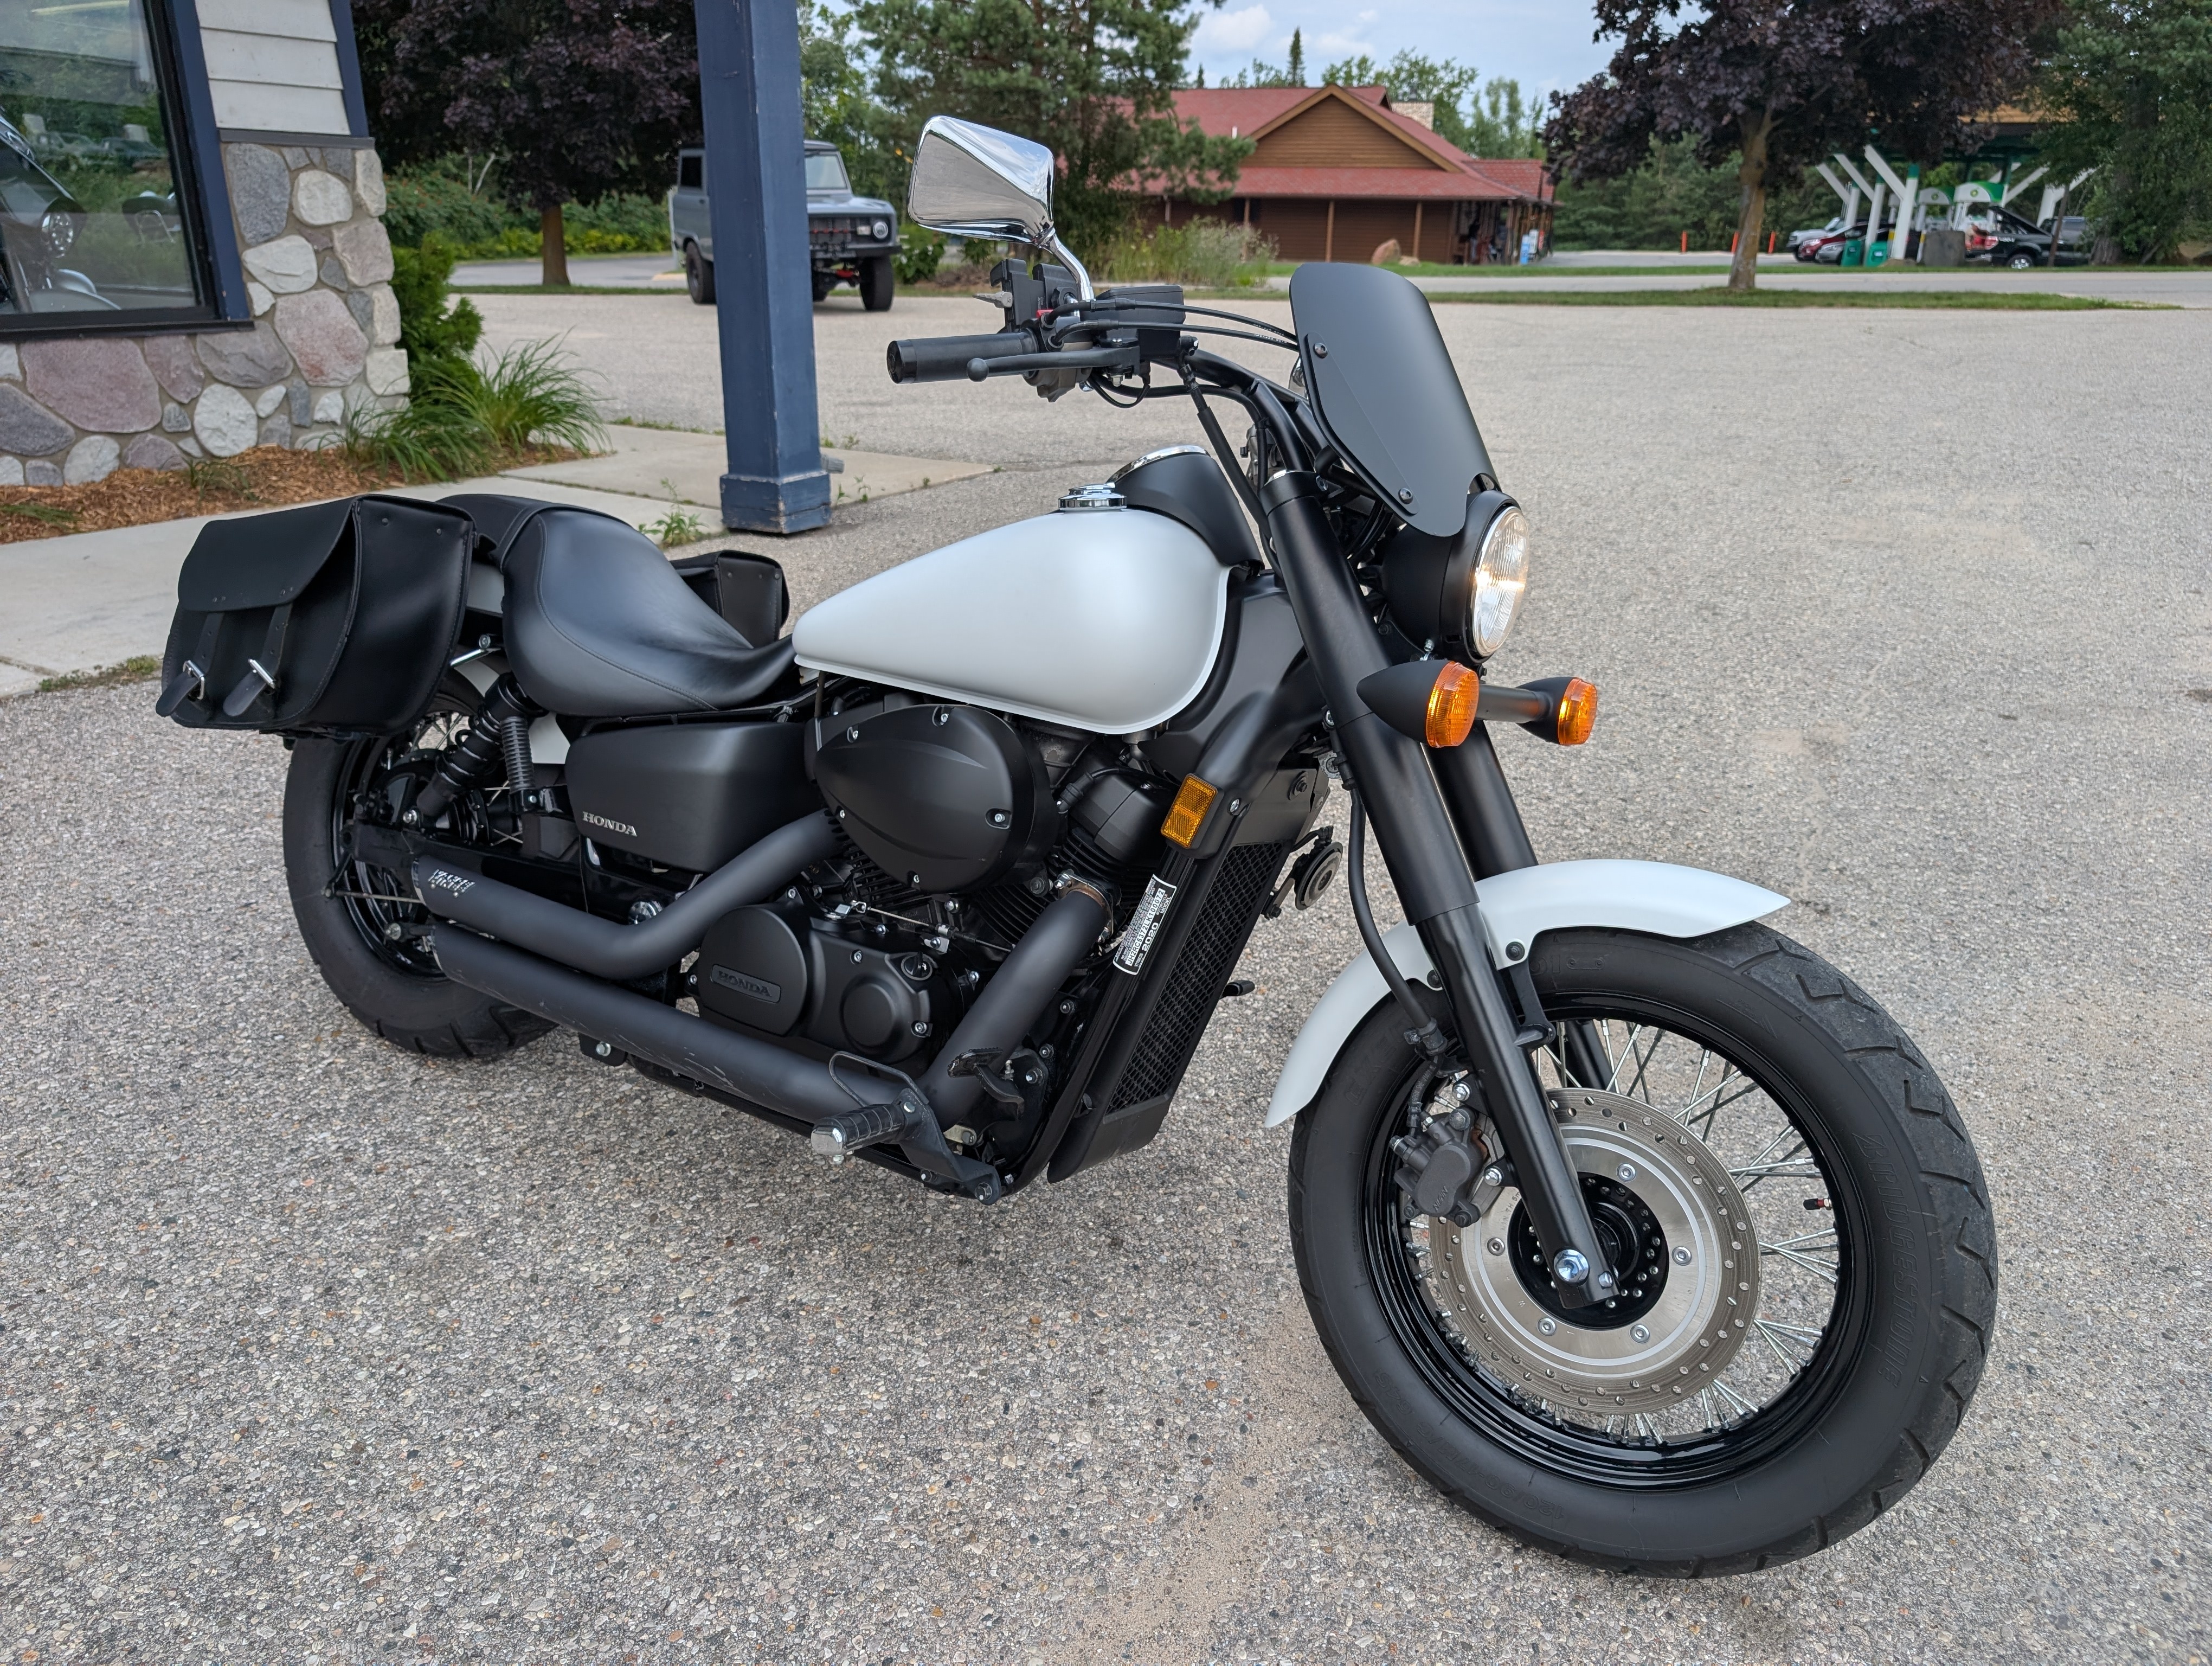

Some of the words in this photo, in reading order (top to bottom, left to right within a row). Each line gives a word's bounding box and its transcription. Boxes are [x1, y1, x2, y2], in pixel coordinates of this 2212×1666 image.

[583, 811, 638, 837] HONDA
[1156, 894, 1168, 915] MOTORCYCLE
[1160, 896, 1172, 913] MODEL
[1127, 890, 1164, 965] JH2RC5372LK100072
[1141, 922, 1159, 951] 2020
[718, 970, 771, 997] HONDA
[1851, 1132, 1919, 1388] BRIDGESTONE
